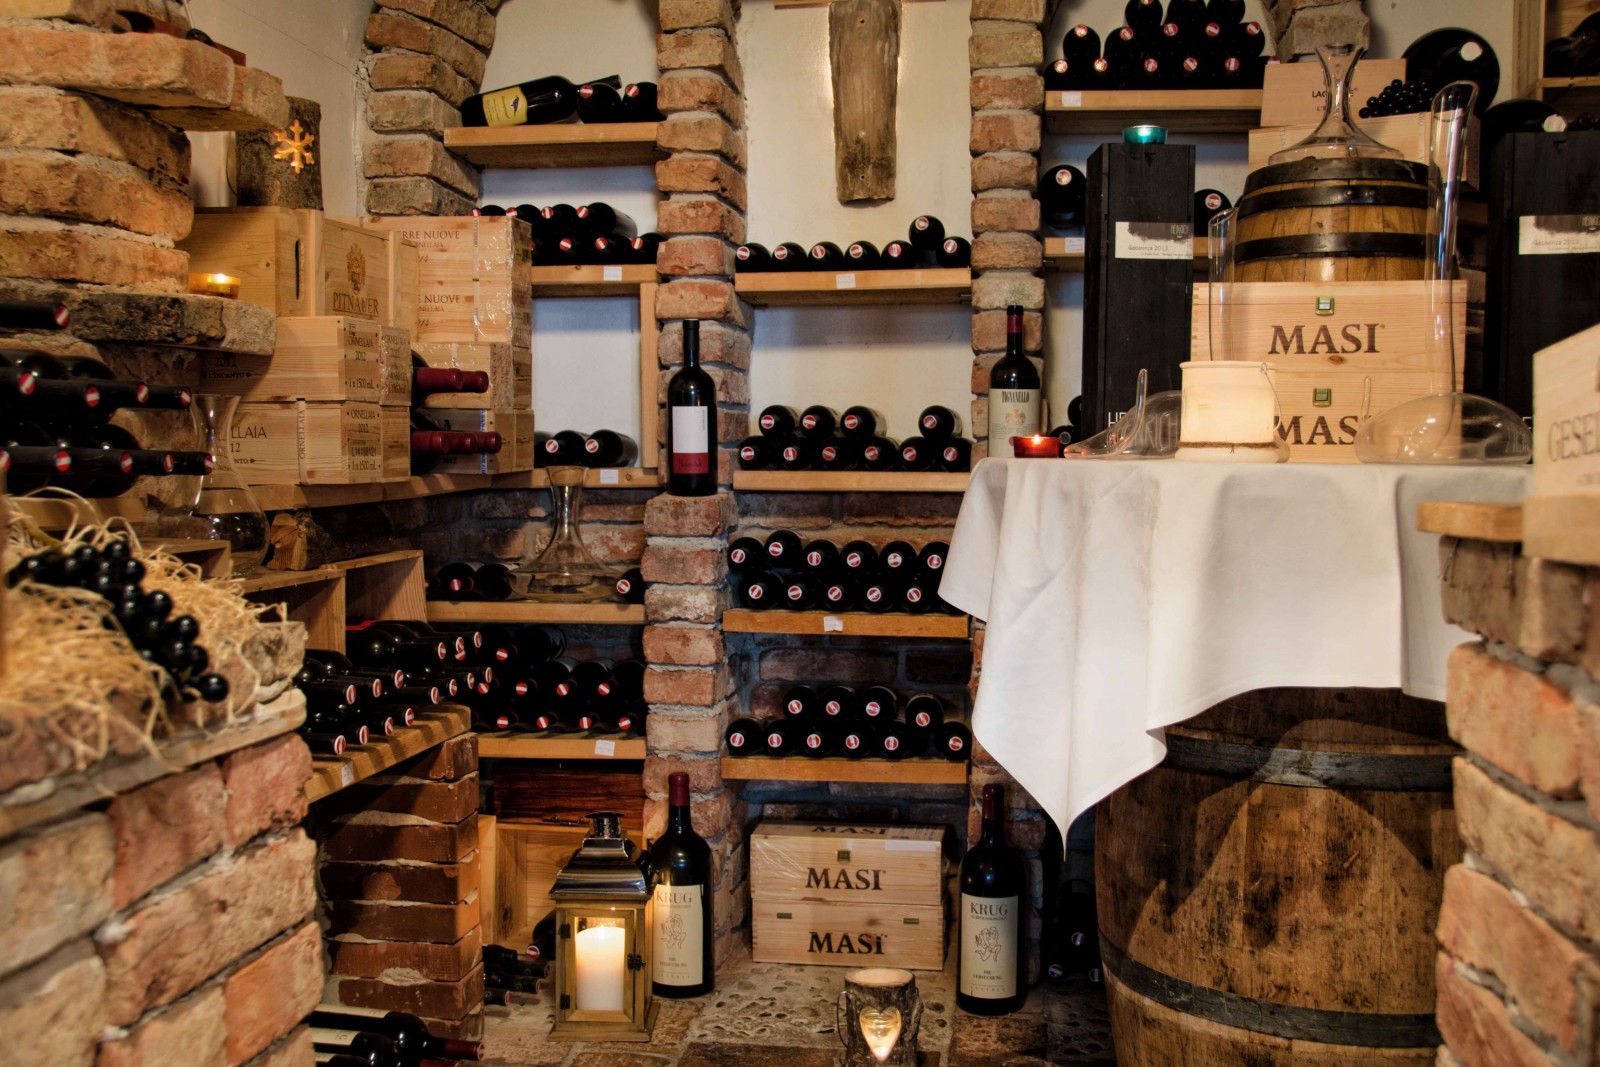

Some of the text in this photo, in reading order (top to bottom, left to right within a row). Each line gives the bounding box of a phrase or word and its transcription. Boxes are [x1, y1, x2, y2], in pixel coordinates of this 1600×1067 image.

[397, 230, 460, 239] RRE NUOVE
[333, 292, 379, 316] PITNAUER
[424, 294, 461, 304] NUOVE
[1267, 323, 1380, 355] MASI
[231, 425, 267, 439] LLAIA
[298, 409, 306, 460] ORNELLAIA
[1273, 415, 1370, 446] MAS
[230, 443, 241, 453] 12
[805, 867, 886, 891] MASI
[656, 892, 692, 904] KRUG
[970, 902, 1008, 916] KRUG
[808, 931, 888, 955] MASI
